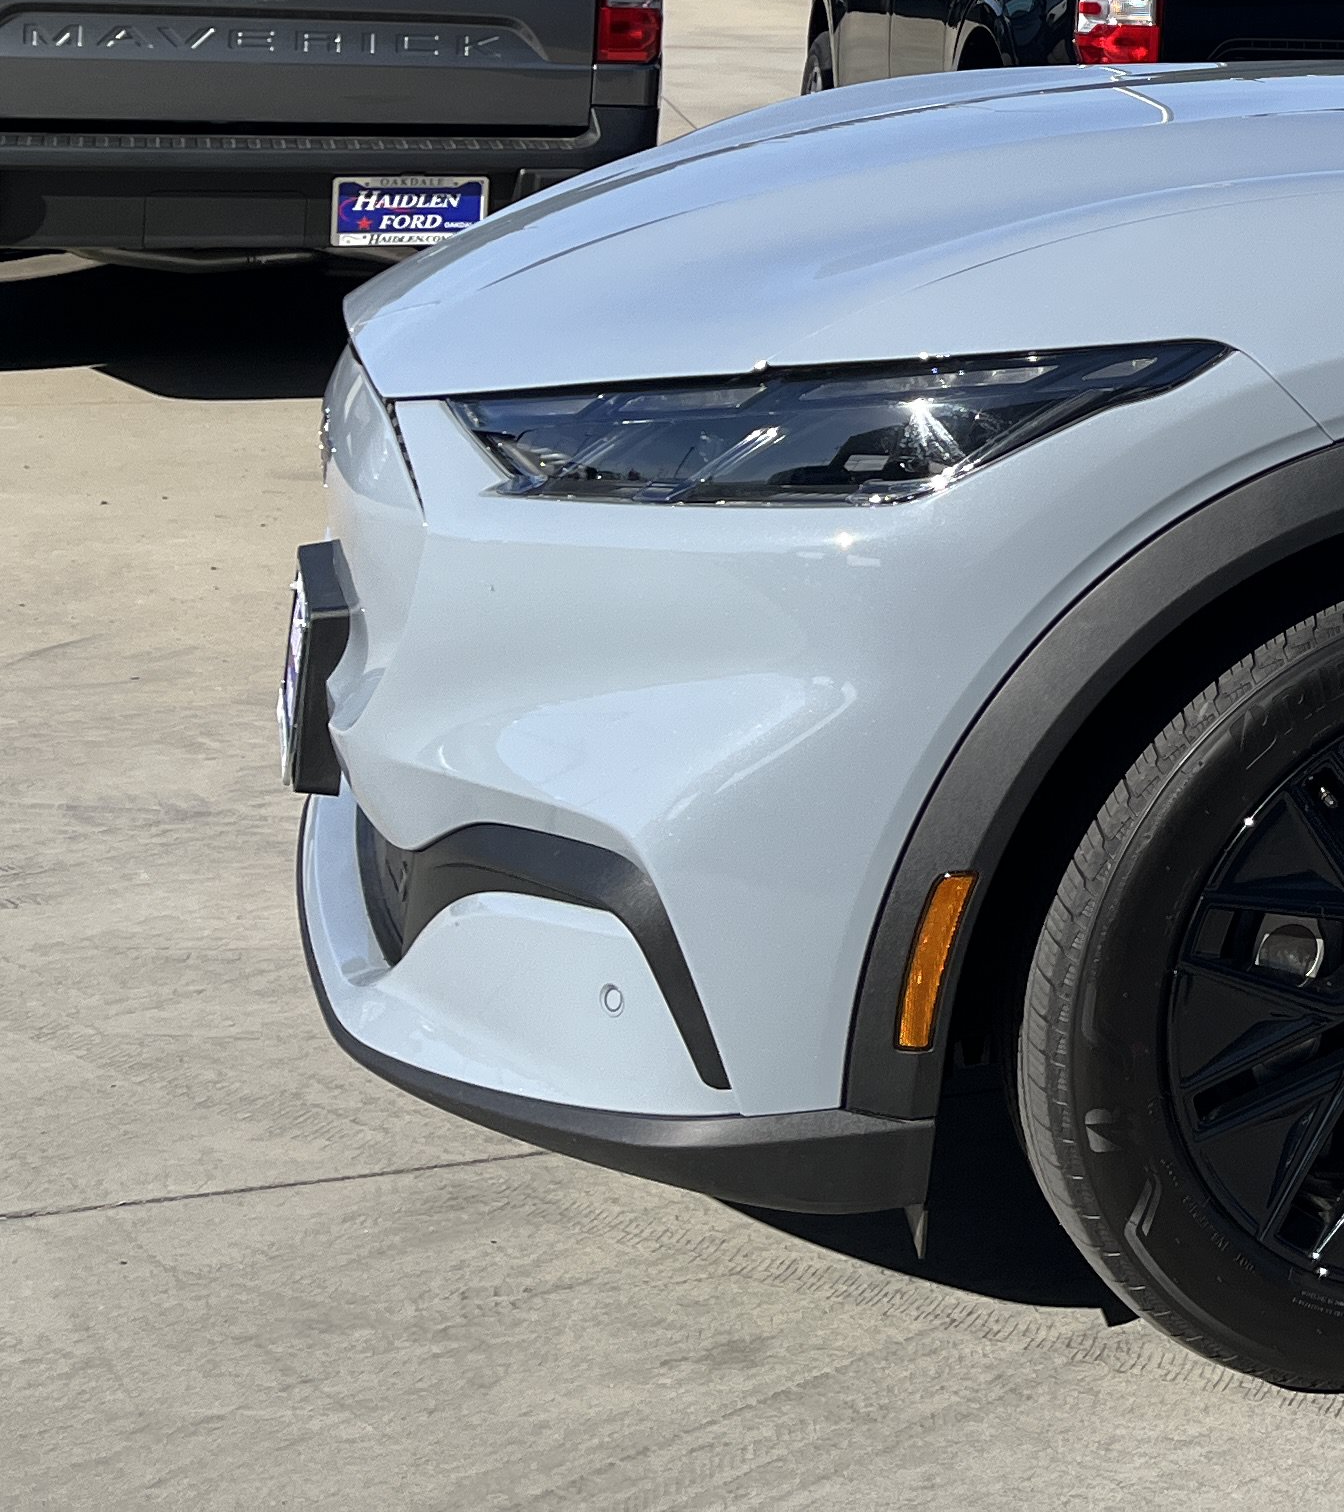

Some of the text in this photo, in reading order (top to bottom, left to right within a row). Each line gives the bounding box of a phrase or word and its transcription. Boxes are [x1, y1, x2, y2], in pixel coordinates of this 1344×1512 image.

[22, 23, 501, 58] MAVERICK
[379, 177, 445, 187] OAKDALE
[352, 190, 461, 211] HAIDLEN
[378, 214, 442, 229] FORD
